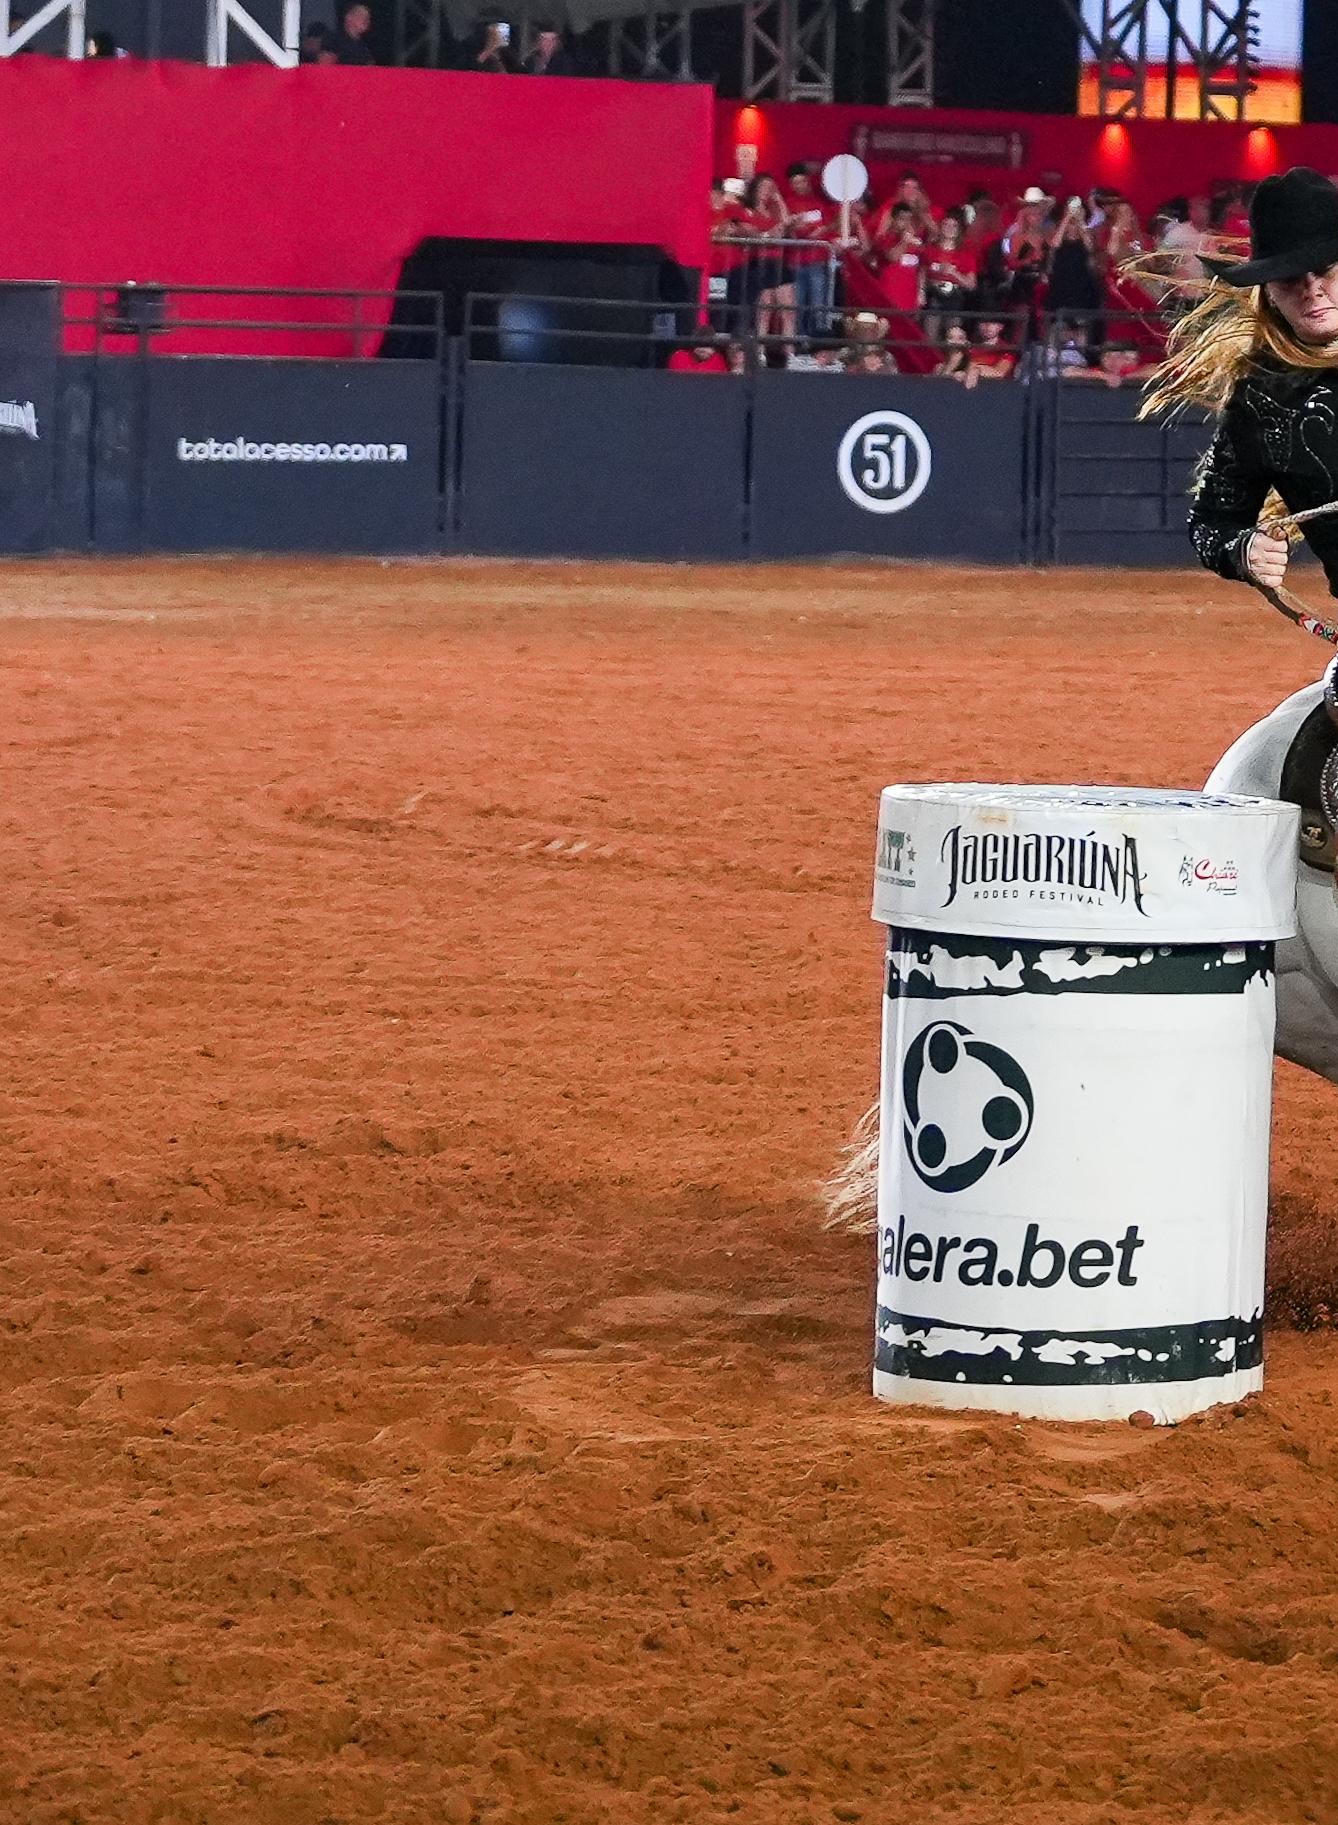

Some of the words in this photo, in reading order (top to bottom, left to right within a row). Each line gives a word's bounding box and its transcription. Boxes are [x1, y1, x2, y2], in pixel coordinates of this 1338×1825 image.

[863, 433, 906, 489] 51
[973, 889, 1019, 900] RODEO
[1029, 889, 1104, 906] FESTIVAL
[880, 1214, 1145, 1288] alera.bet
